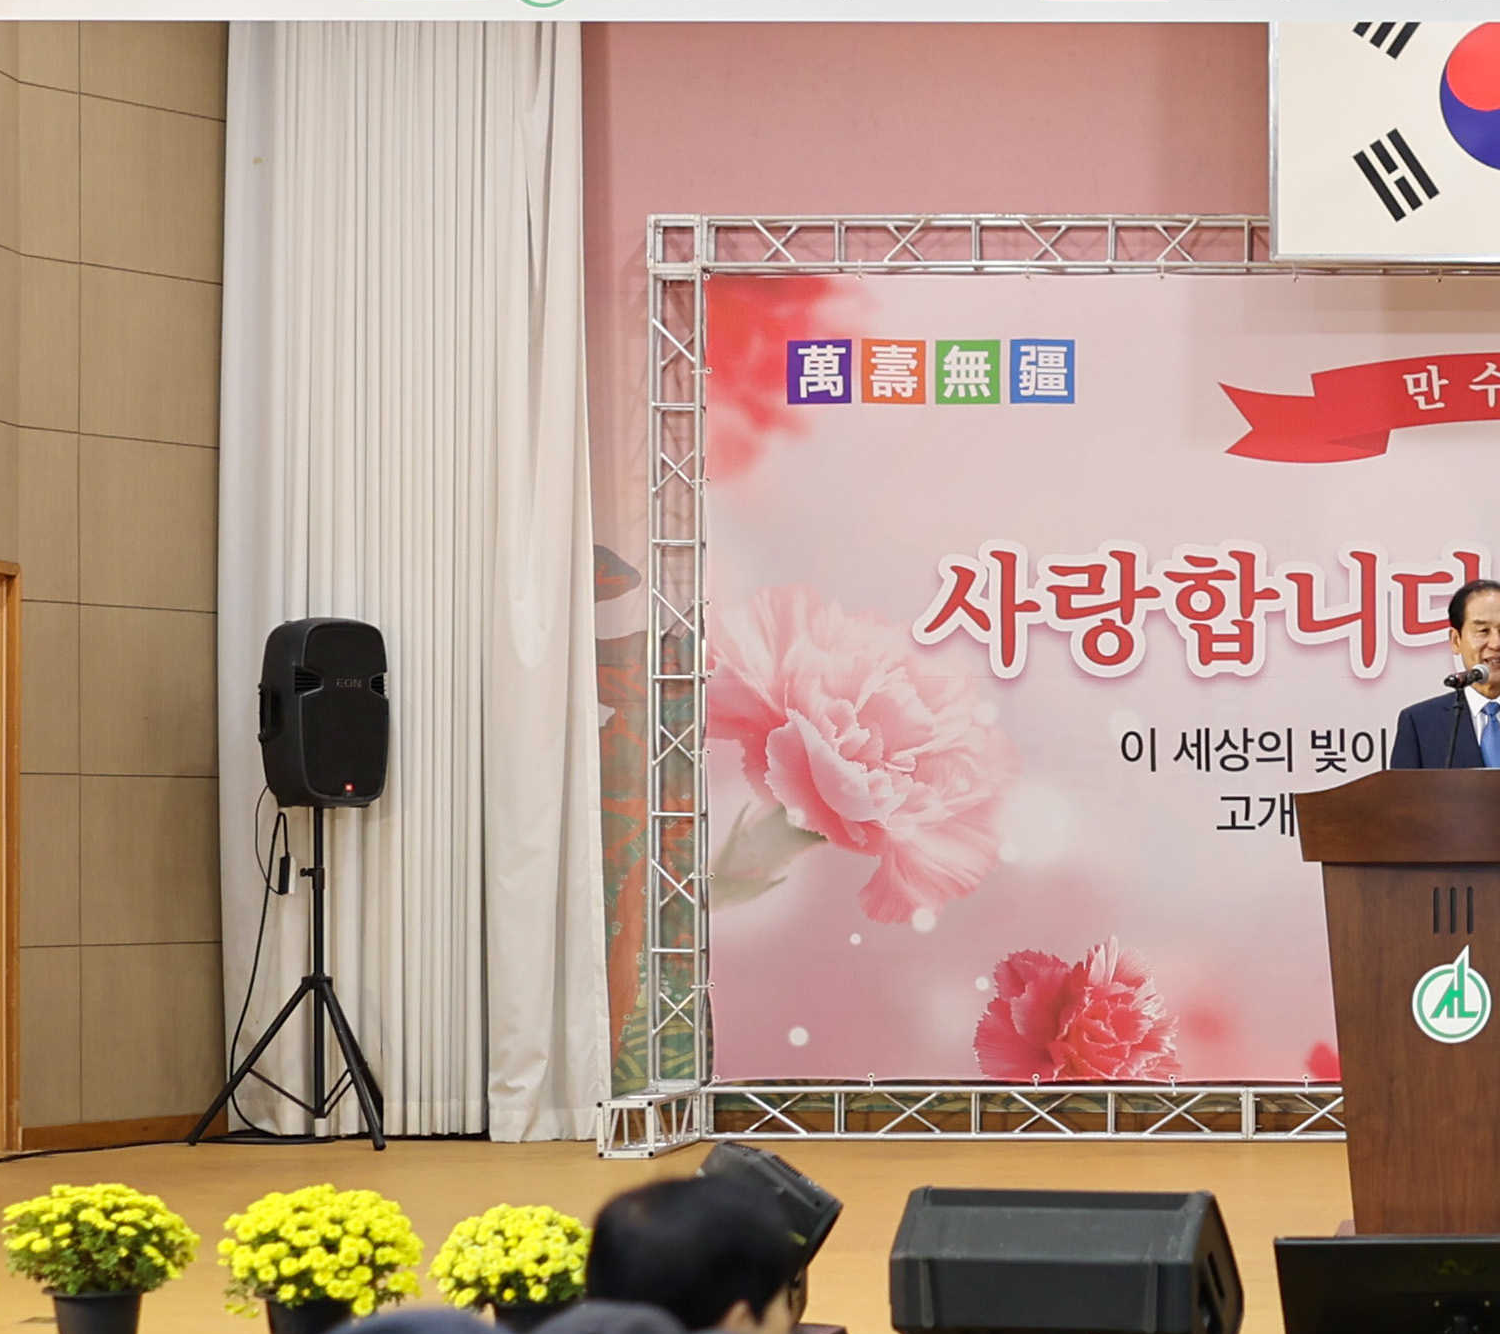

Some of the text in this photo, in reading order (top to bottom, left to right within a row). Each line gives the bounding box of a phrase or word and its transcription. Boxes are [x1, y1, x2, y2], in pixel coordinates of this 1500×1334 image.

[928, 547, 1481, 673] 사랑합니다
[1120, 727, 1157, 774] 이
[1173, 727, 1294, 773] 세상의
[1310, 727, 1388, 774] 빛이
[1216, 792, 1296, 838] 고개
